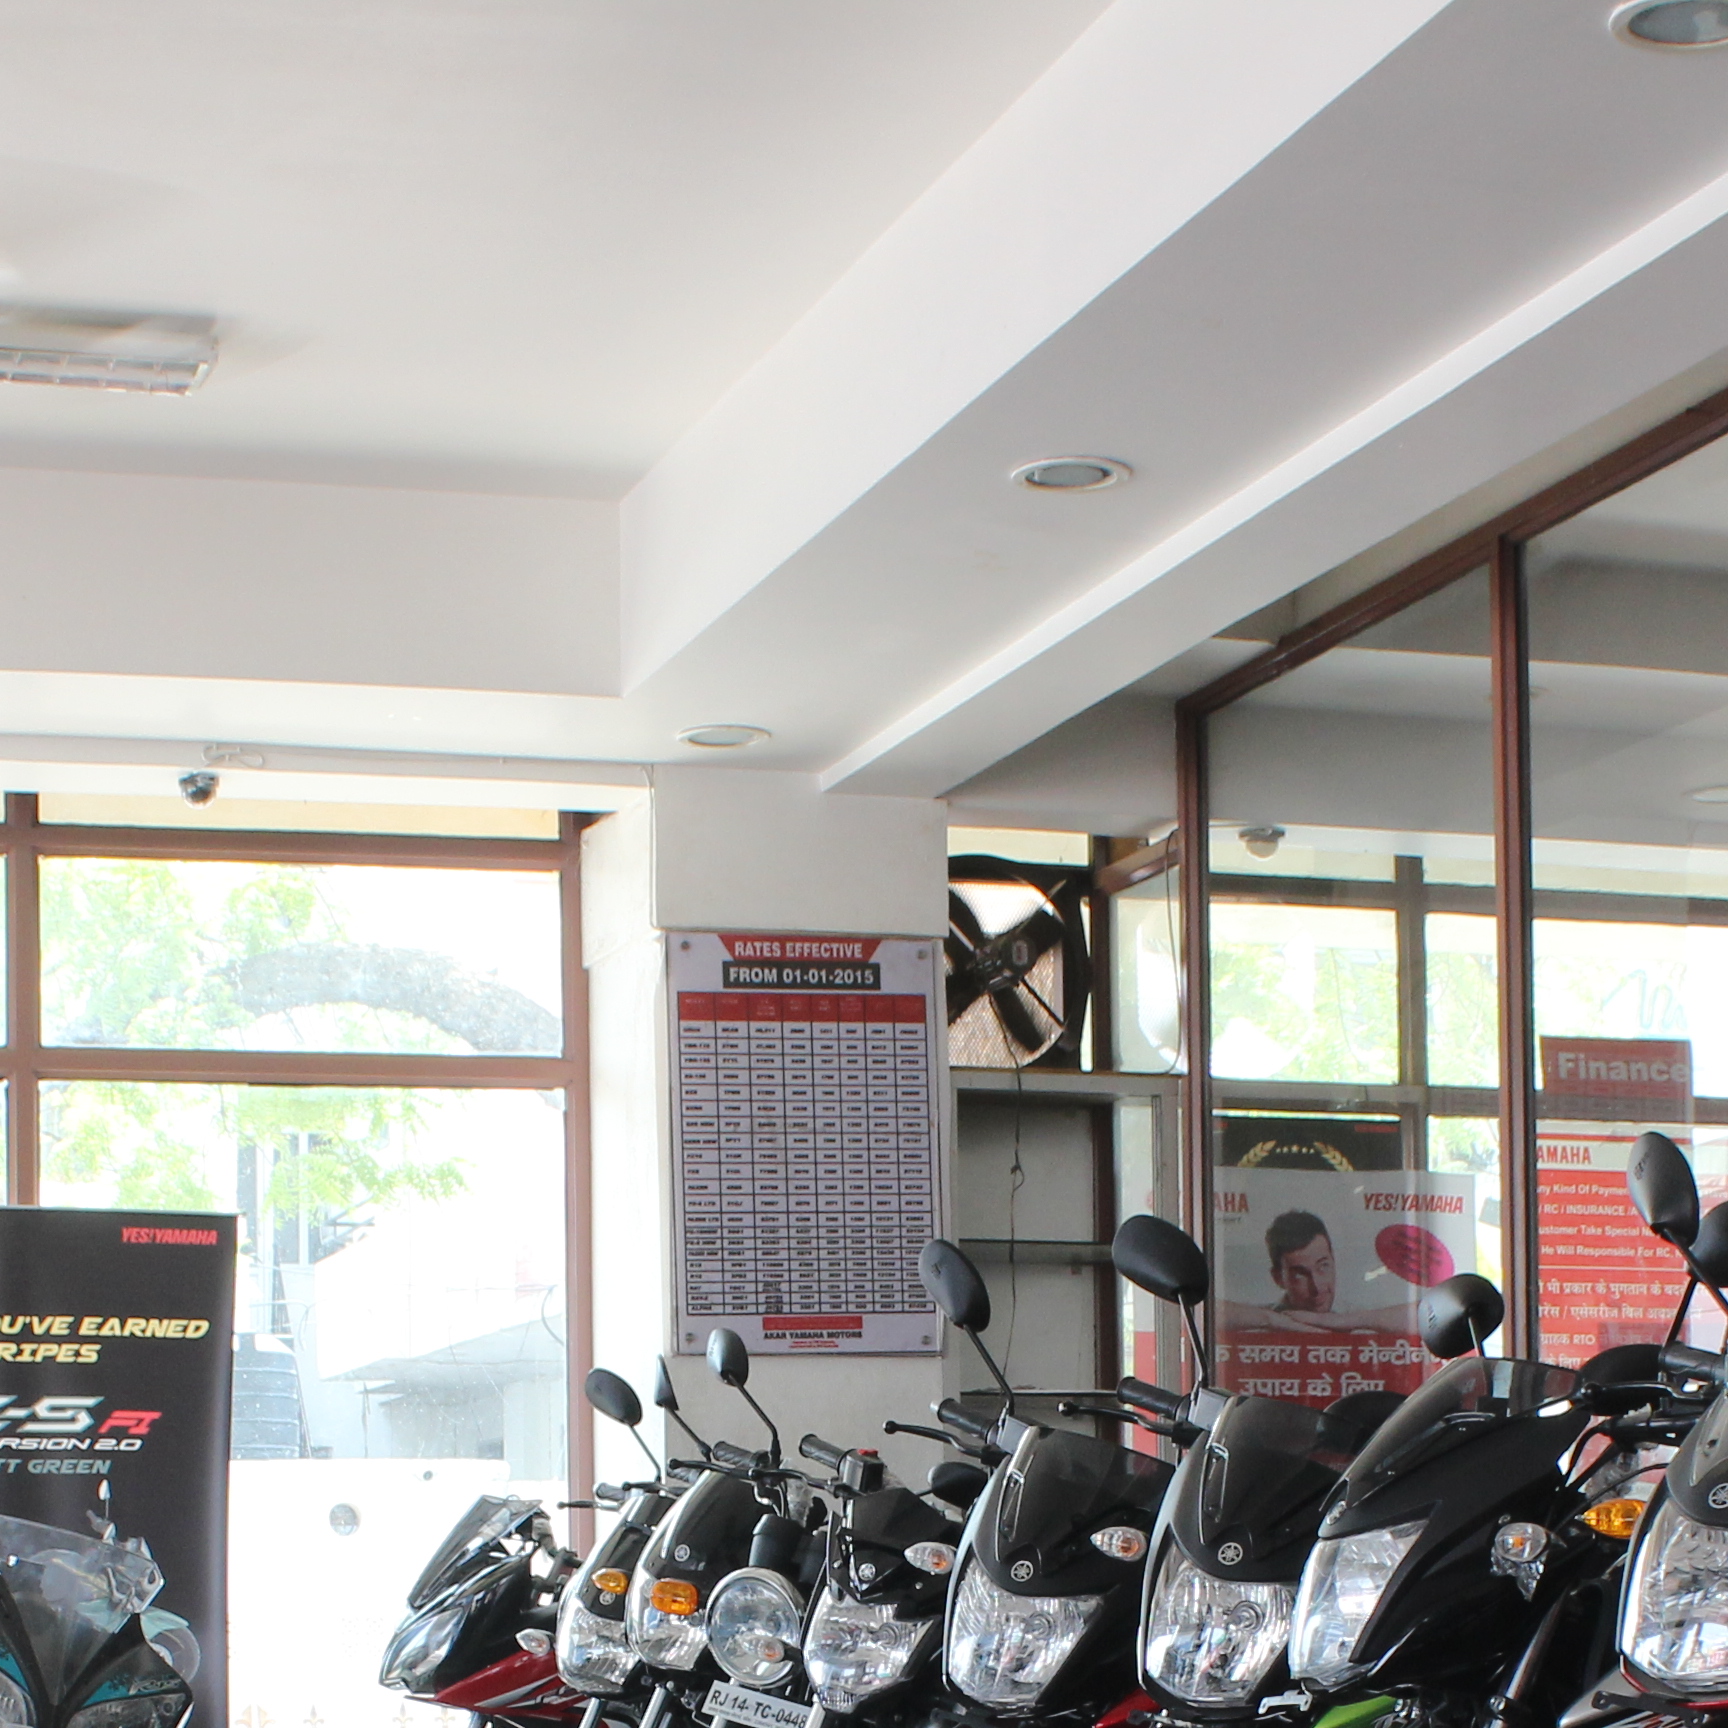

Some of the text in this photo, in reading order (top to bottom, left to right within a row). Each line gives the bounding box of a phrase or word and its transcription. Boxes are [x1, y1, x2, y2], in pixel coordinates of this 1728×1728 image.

[734, 941, 863, 959] RATES EFFECTIVE
[729, 966, 874, 984] FROM 01-01-2015
[1557, 1051, 1690, 1082] Finance
[1537, 1146, 1592, 1165] AMAHA
[1553, 1184, 1576, 1194] Kind
[1577, 1184, 1590, 1194] Of
[1363, 1193, 1465, 1214] YES!YAMAHA
[1544, 1205, 1559, 1214] RC
[1566, 1206, 1625, 1216] INSURANCE
[1538, 1225, 1640, 1237] ustomer Take Special
[1541, 1245, 1554, 1255] He
[1556, 1245, 1575, 1255] Will
[1576, 1246, 1635, 1257] Responsible
[1637, 1247, 1655, 1257] For
[78, 1317, 210, 1339] EARNED
[763, 1332, 787, 1341] AKAR
[790, 1332, 824, 1340] YAMAHA
[1238, 1345, 1301, 1366] समय
[1307, 1346, 1352, 1365] तक
[1238, 1378, 1301, 1398] उपाय
[1307, 1373, 1333, 1397] के
[98, 1411, 162, 1435] FI
[92, 1438, 144, 1451] 2.0
[27, 1459, 112, 1475] GREEN
[709, 1688, 729, 1706] RJ
